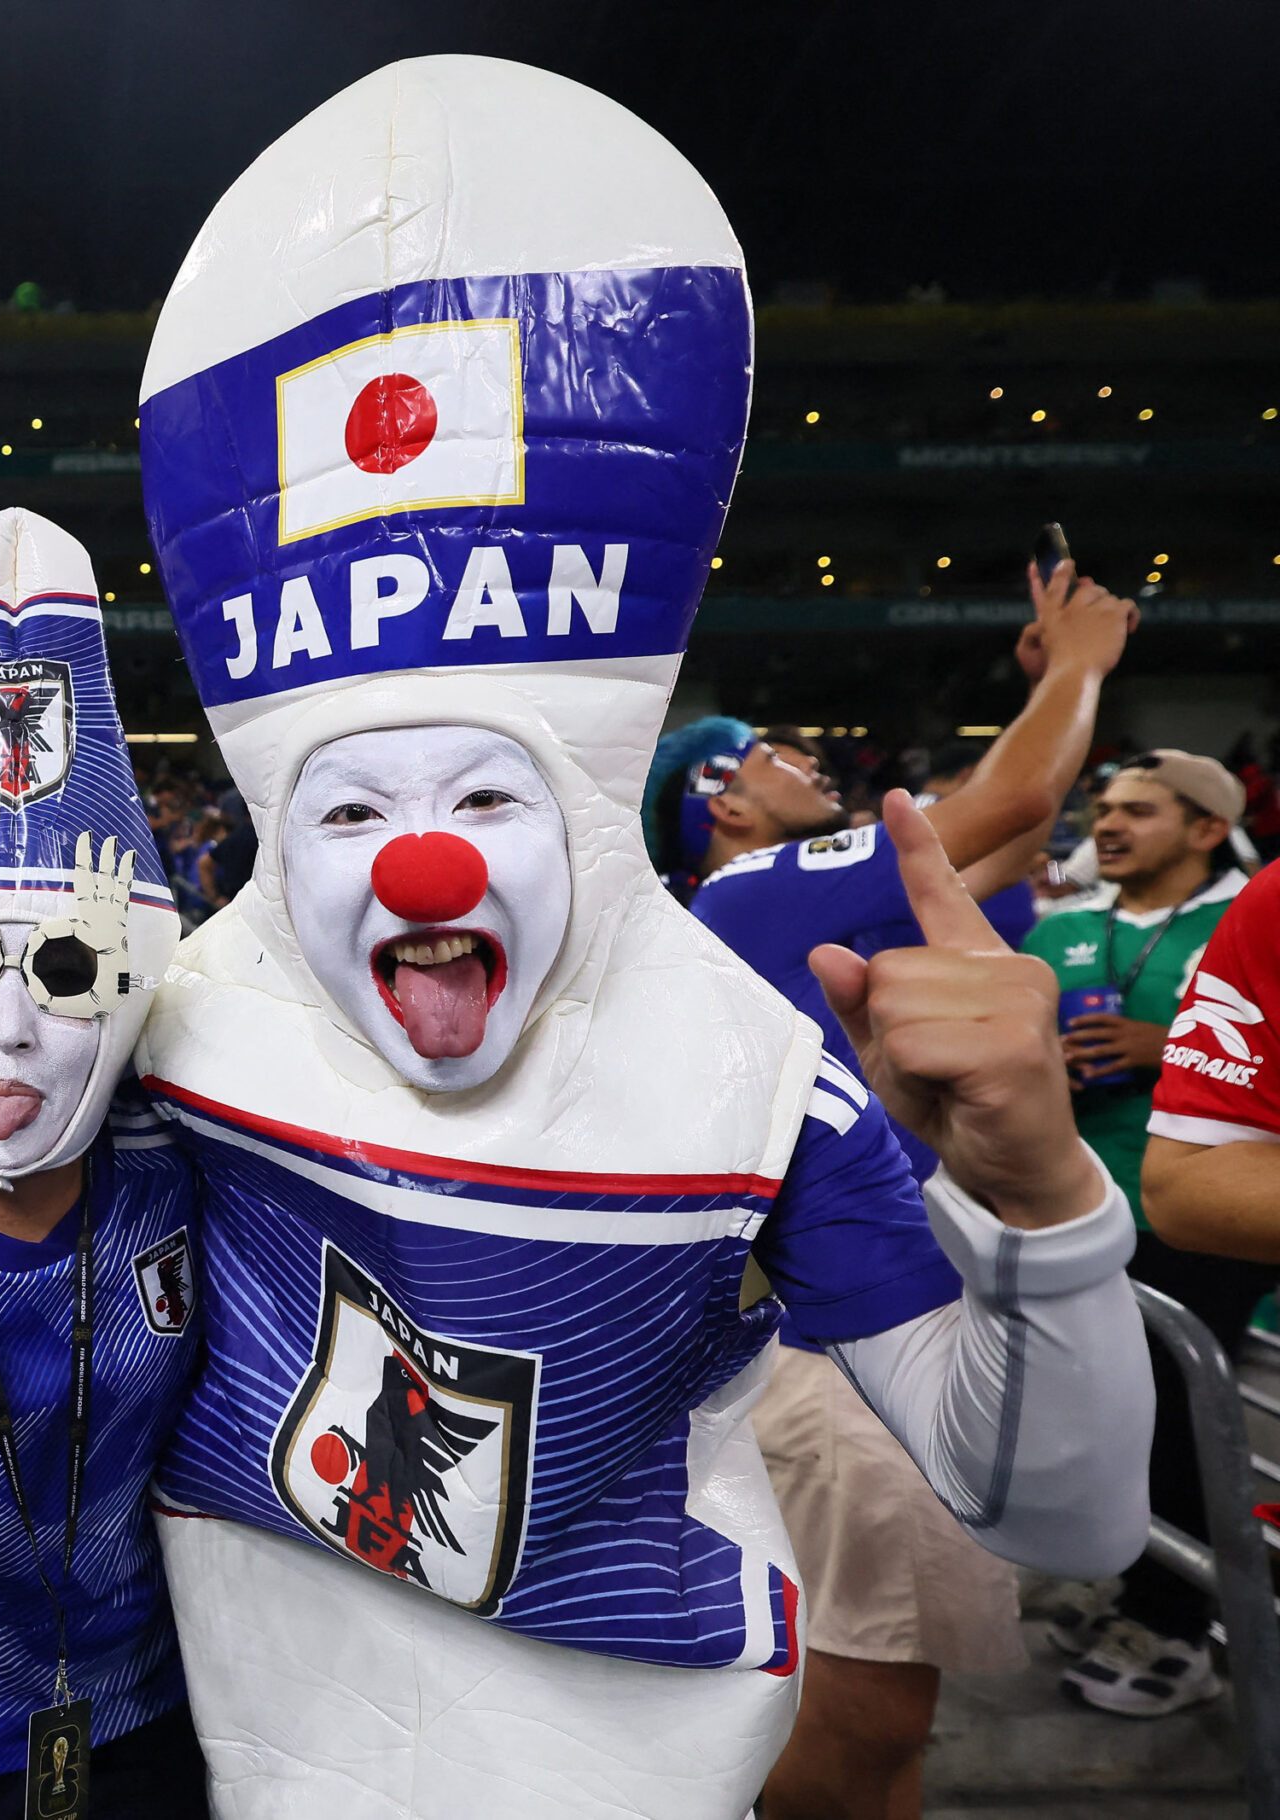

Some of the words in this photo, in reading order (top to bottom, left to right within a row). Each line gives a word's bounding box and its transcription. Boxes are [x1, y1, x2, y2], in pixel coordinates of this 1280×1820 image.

[221, 543, 630, 680] JAPAN
[148, 1240, 176, 1262] JAPAN
[368, 1290, 459, 1381] JAPAN
[320, 1496, 433, 1590] JFA
